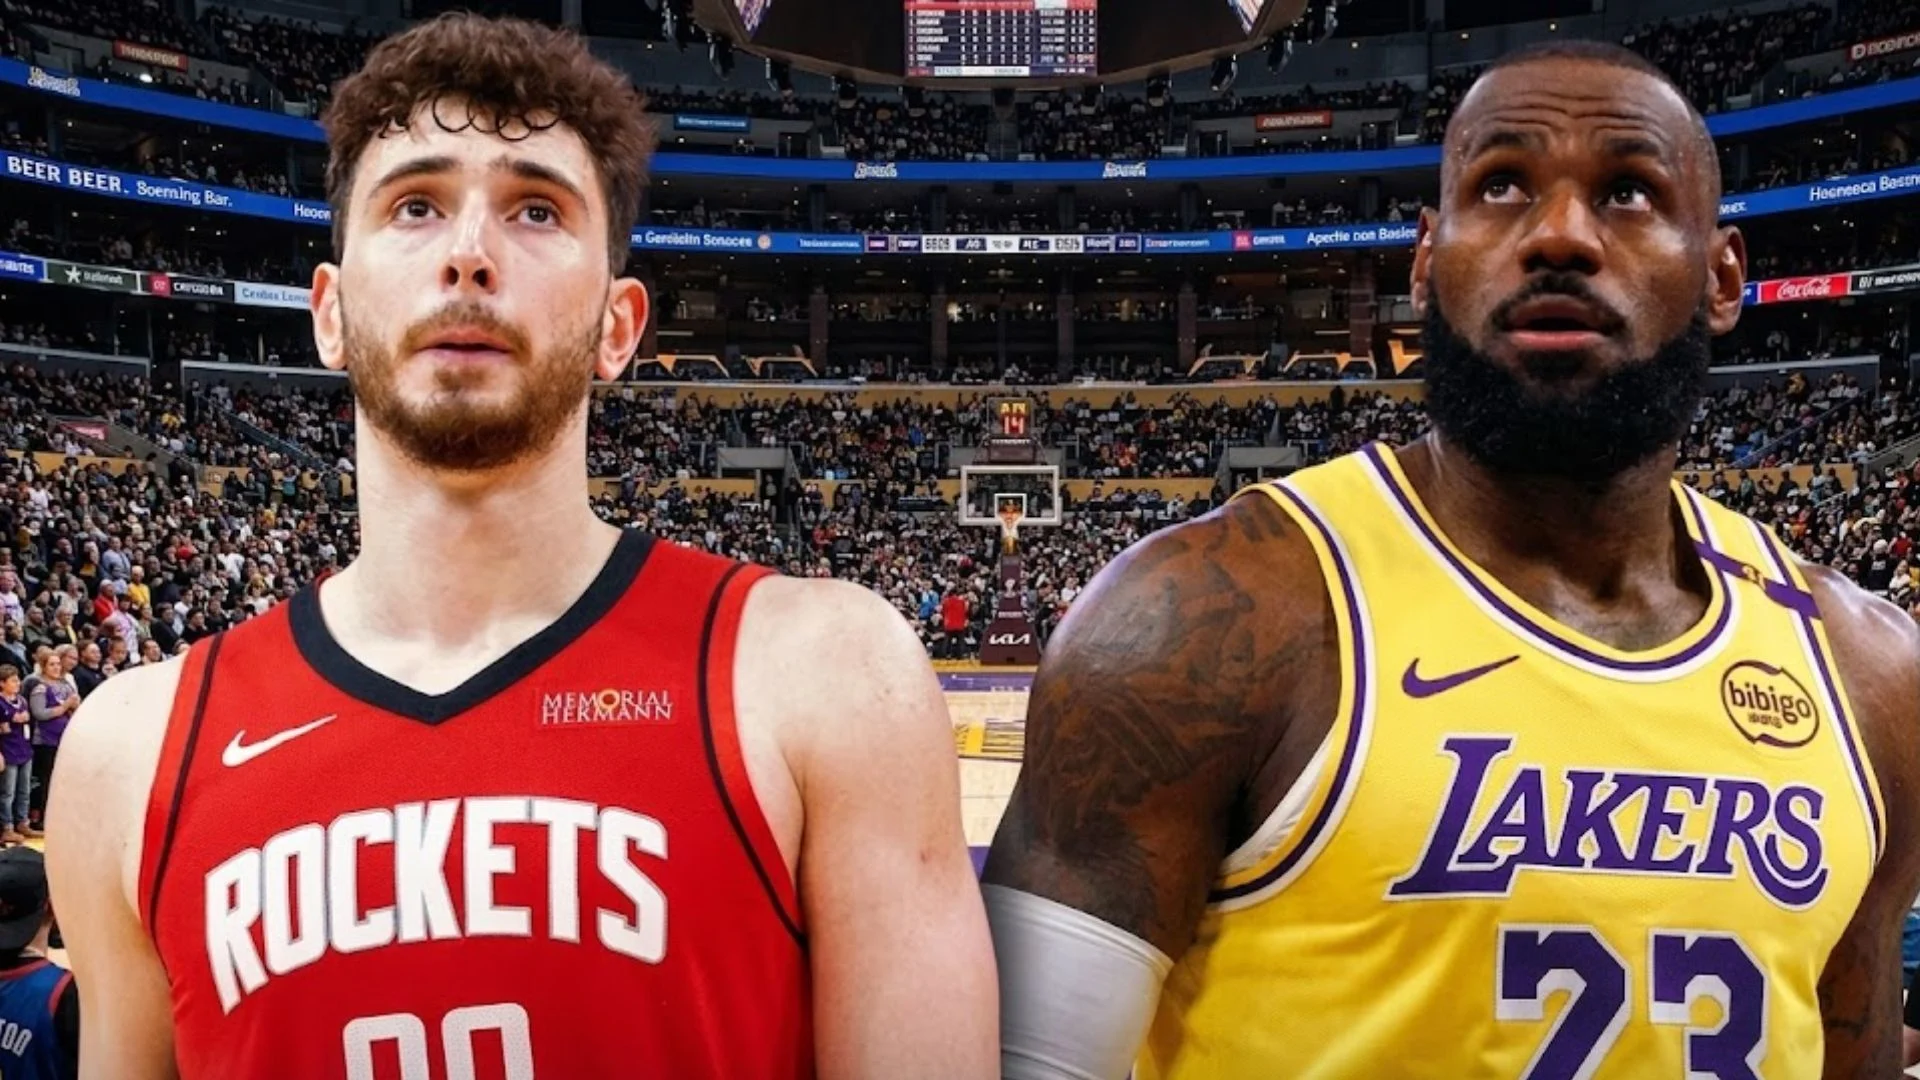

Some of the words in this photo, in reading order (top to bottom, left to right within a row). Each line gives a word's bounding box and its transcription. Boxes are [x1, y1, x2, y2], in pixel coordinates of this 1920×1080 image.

[8, 156, 61, 183] BEER
[542, 703, 673, 725] HERMANN
[543, 689, 669, 710] MEMORIAL
[1728, 679, 1812, 725] bibigo
[1383, 735, 1830, 910] LAKERS
[204, 795, 668, 1017] ROCKETS
[1494, 921, 1768, 1080] 23
